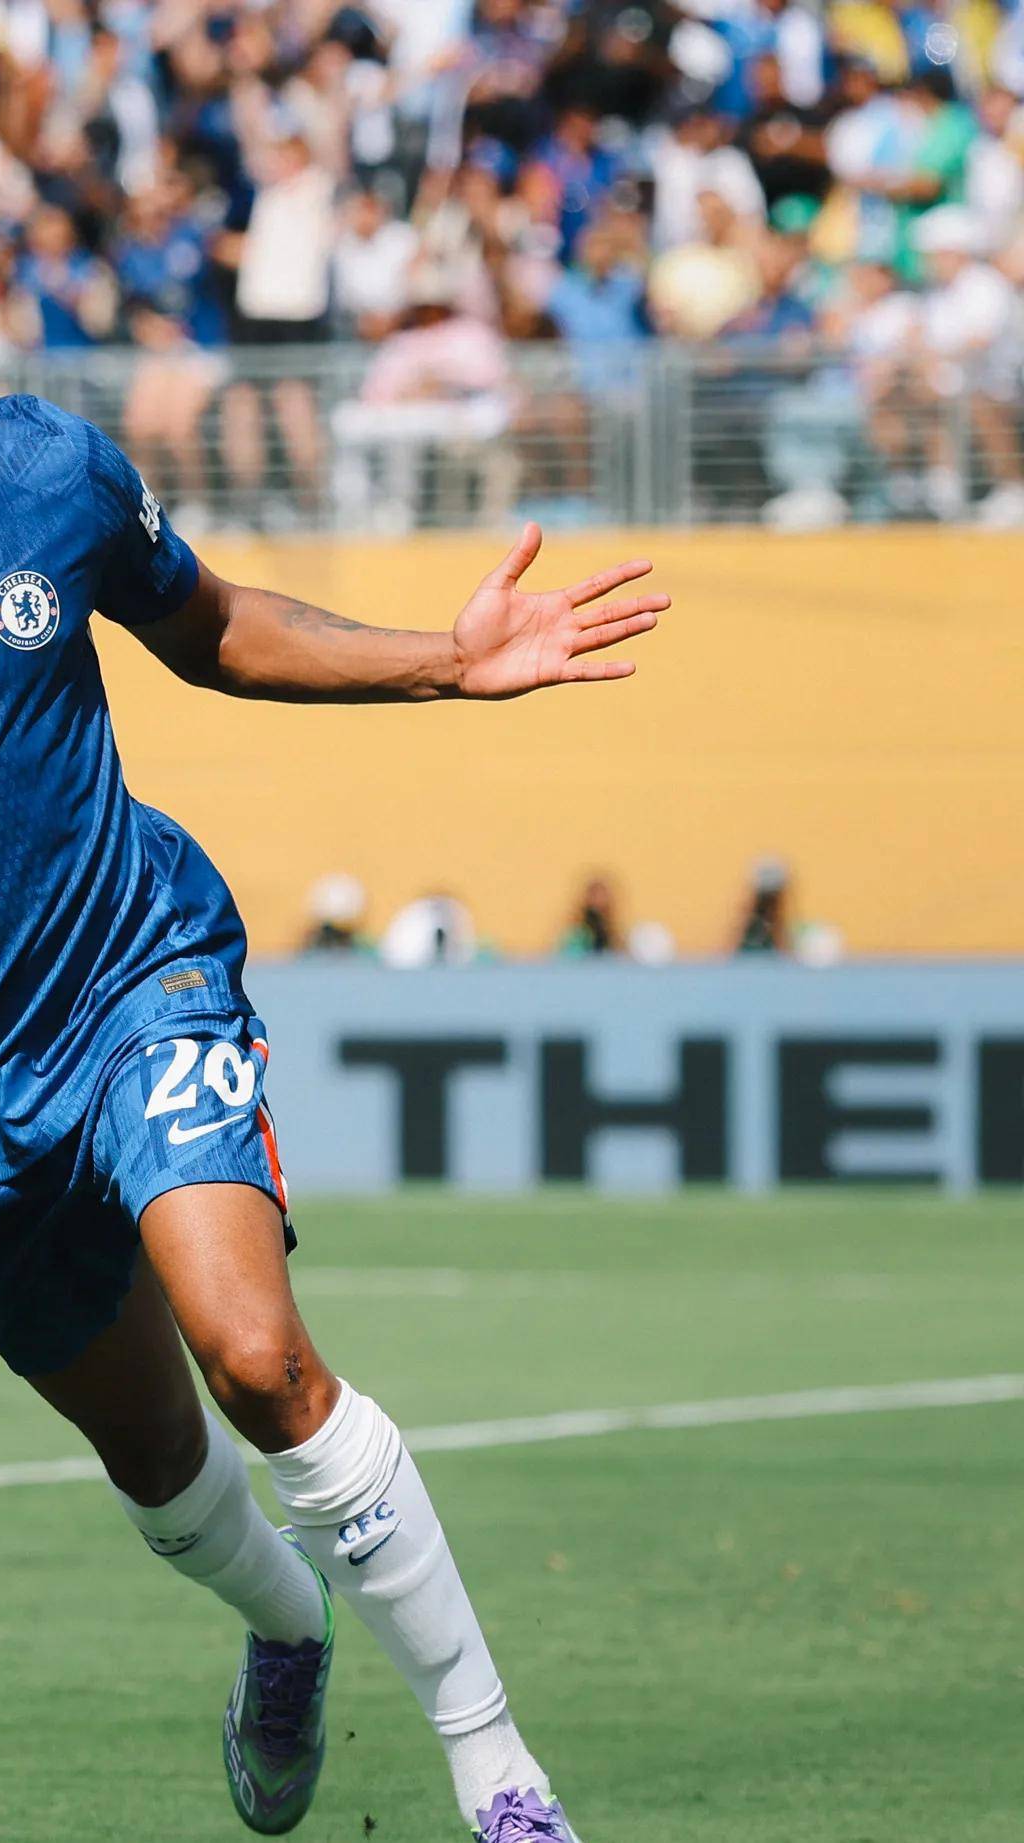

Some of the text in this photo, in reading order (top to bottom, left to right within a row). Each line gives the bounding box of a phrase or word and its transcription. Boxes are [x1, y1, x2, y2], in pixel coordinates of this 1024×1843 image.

[8, 625, 53, 646] FOOTBALL CLUB
[144, 1038, 256, 1120] 20
[337, 1034, 1024, 1182] THE
[338, 1501, 395, 1545] CFC
